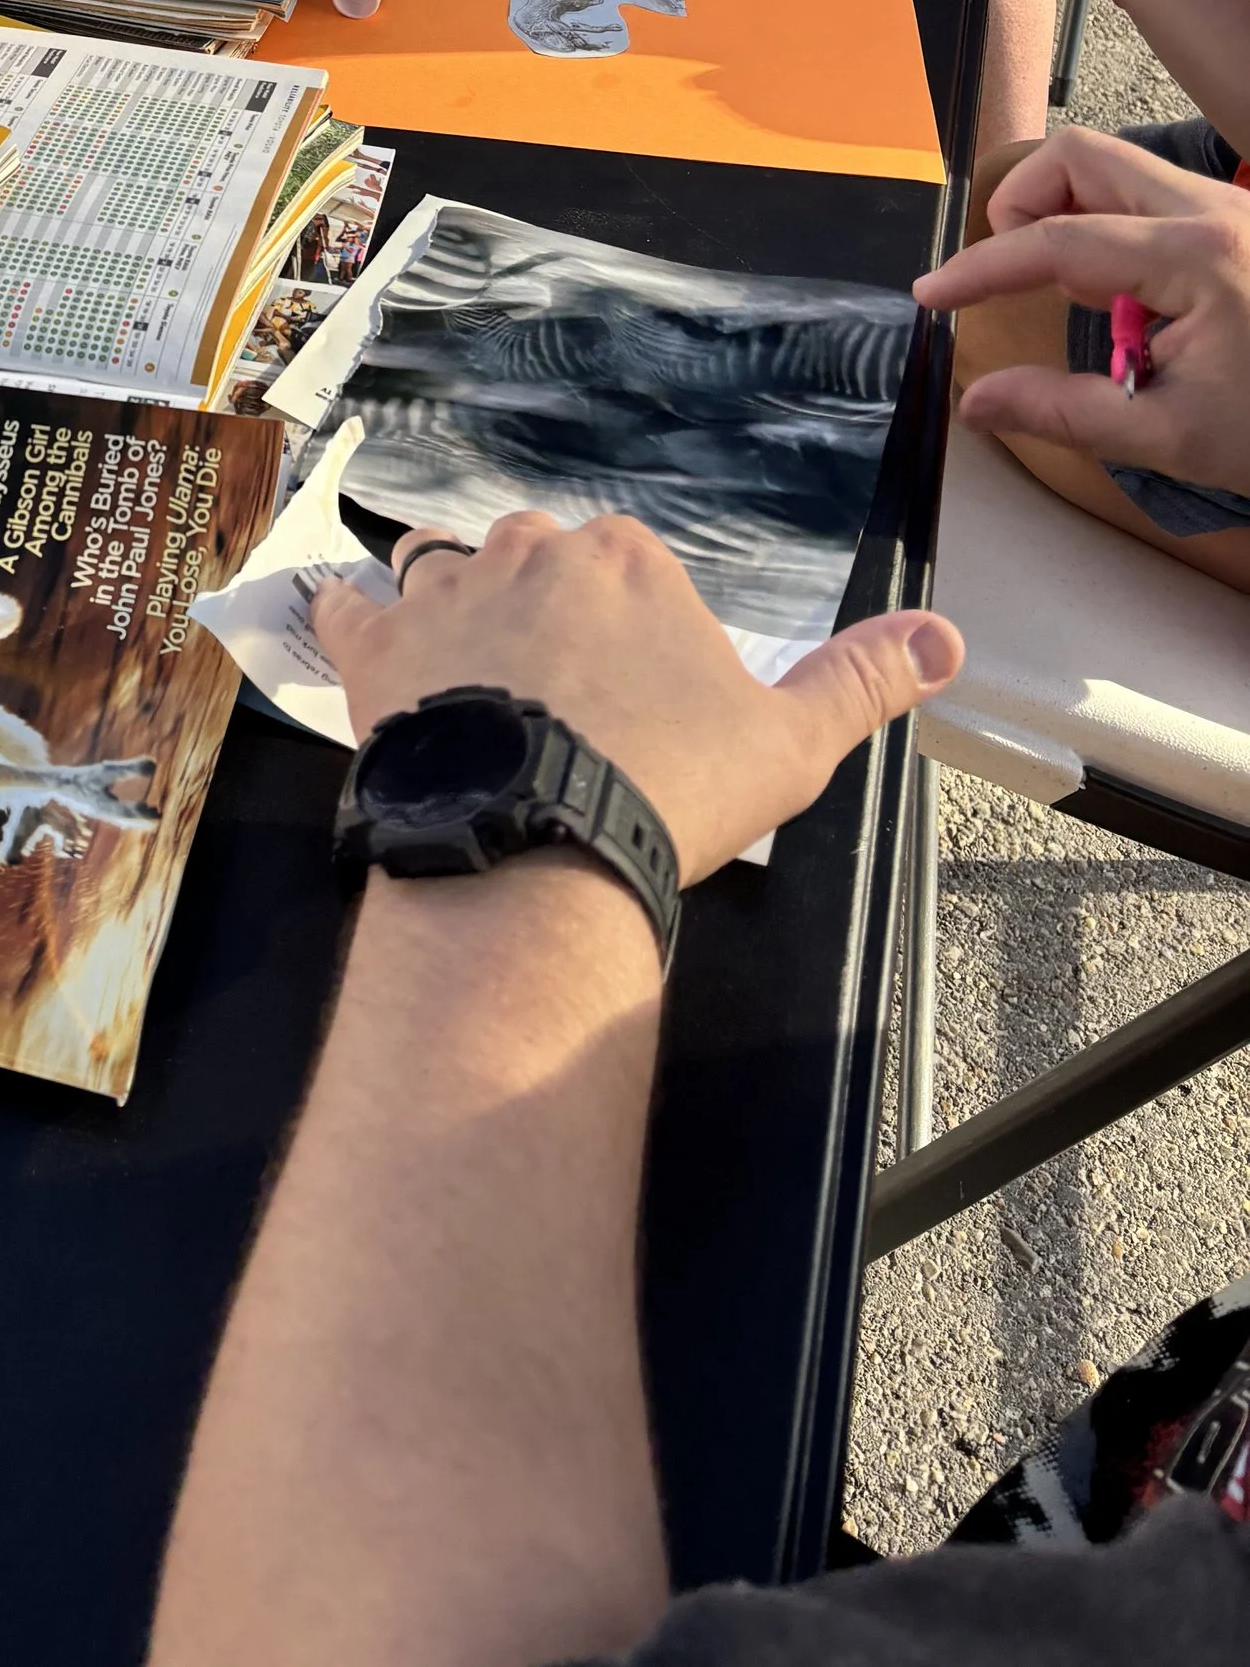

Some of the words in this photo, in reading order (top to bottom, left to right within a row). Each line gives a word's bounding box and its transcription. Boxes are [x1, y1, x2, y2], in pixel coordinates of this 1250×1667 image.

[125, 434, 147, 463] of
[134, 438, 168, 522] Jones?
[195, 447, 222, 486] Die
[3, 469, 41, 549] Gibson
[25, 423, 51, 463] Girl
[25, 471, 67, 558] Among
[46, 426, 72, 465] the
[51, 430, 93, 542] Cannibals
[70, 515, 108, 589] Who's
[90, 433, 124, 511] Buried
[108, 467, 139, 534] Tomb
[165, 444, 200, 525] Ulama:
[186, 492, 214, 538] You
[98, 539, 125, 580] the
[121, 525, 151, 578] Paul
[146, 530, 187, 619] Playing
[179, 546, 209, 609] Lose,
[89, 581, 115, 606] in
[107, 583, 138, 641] John
[159, 613, 191, 656] You
